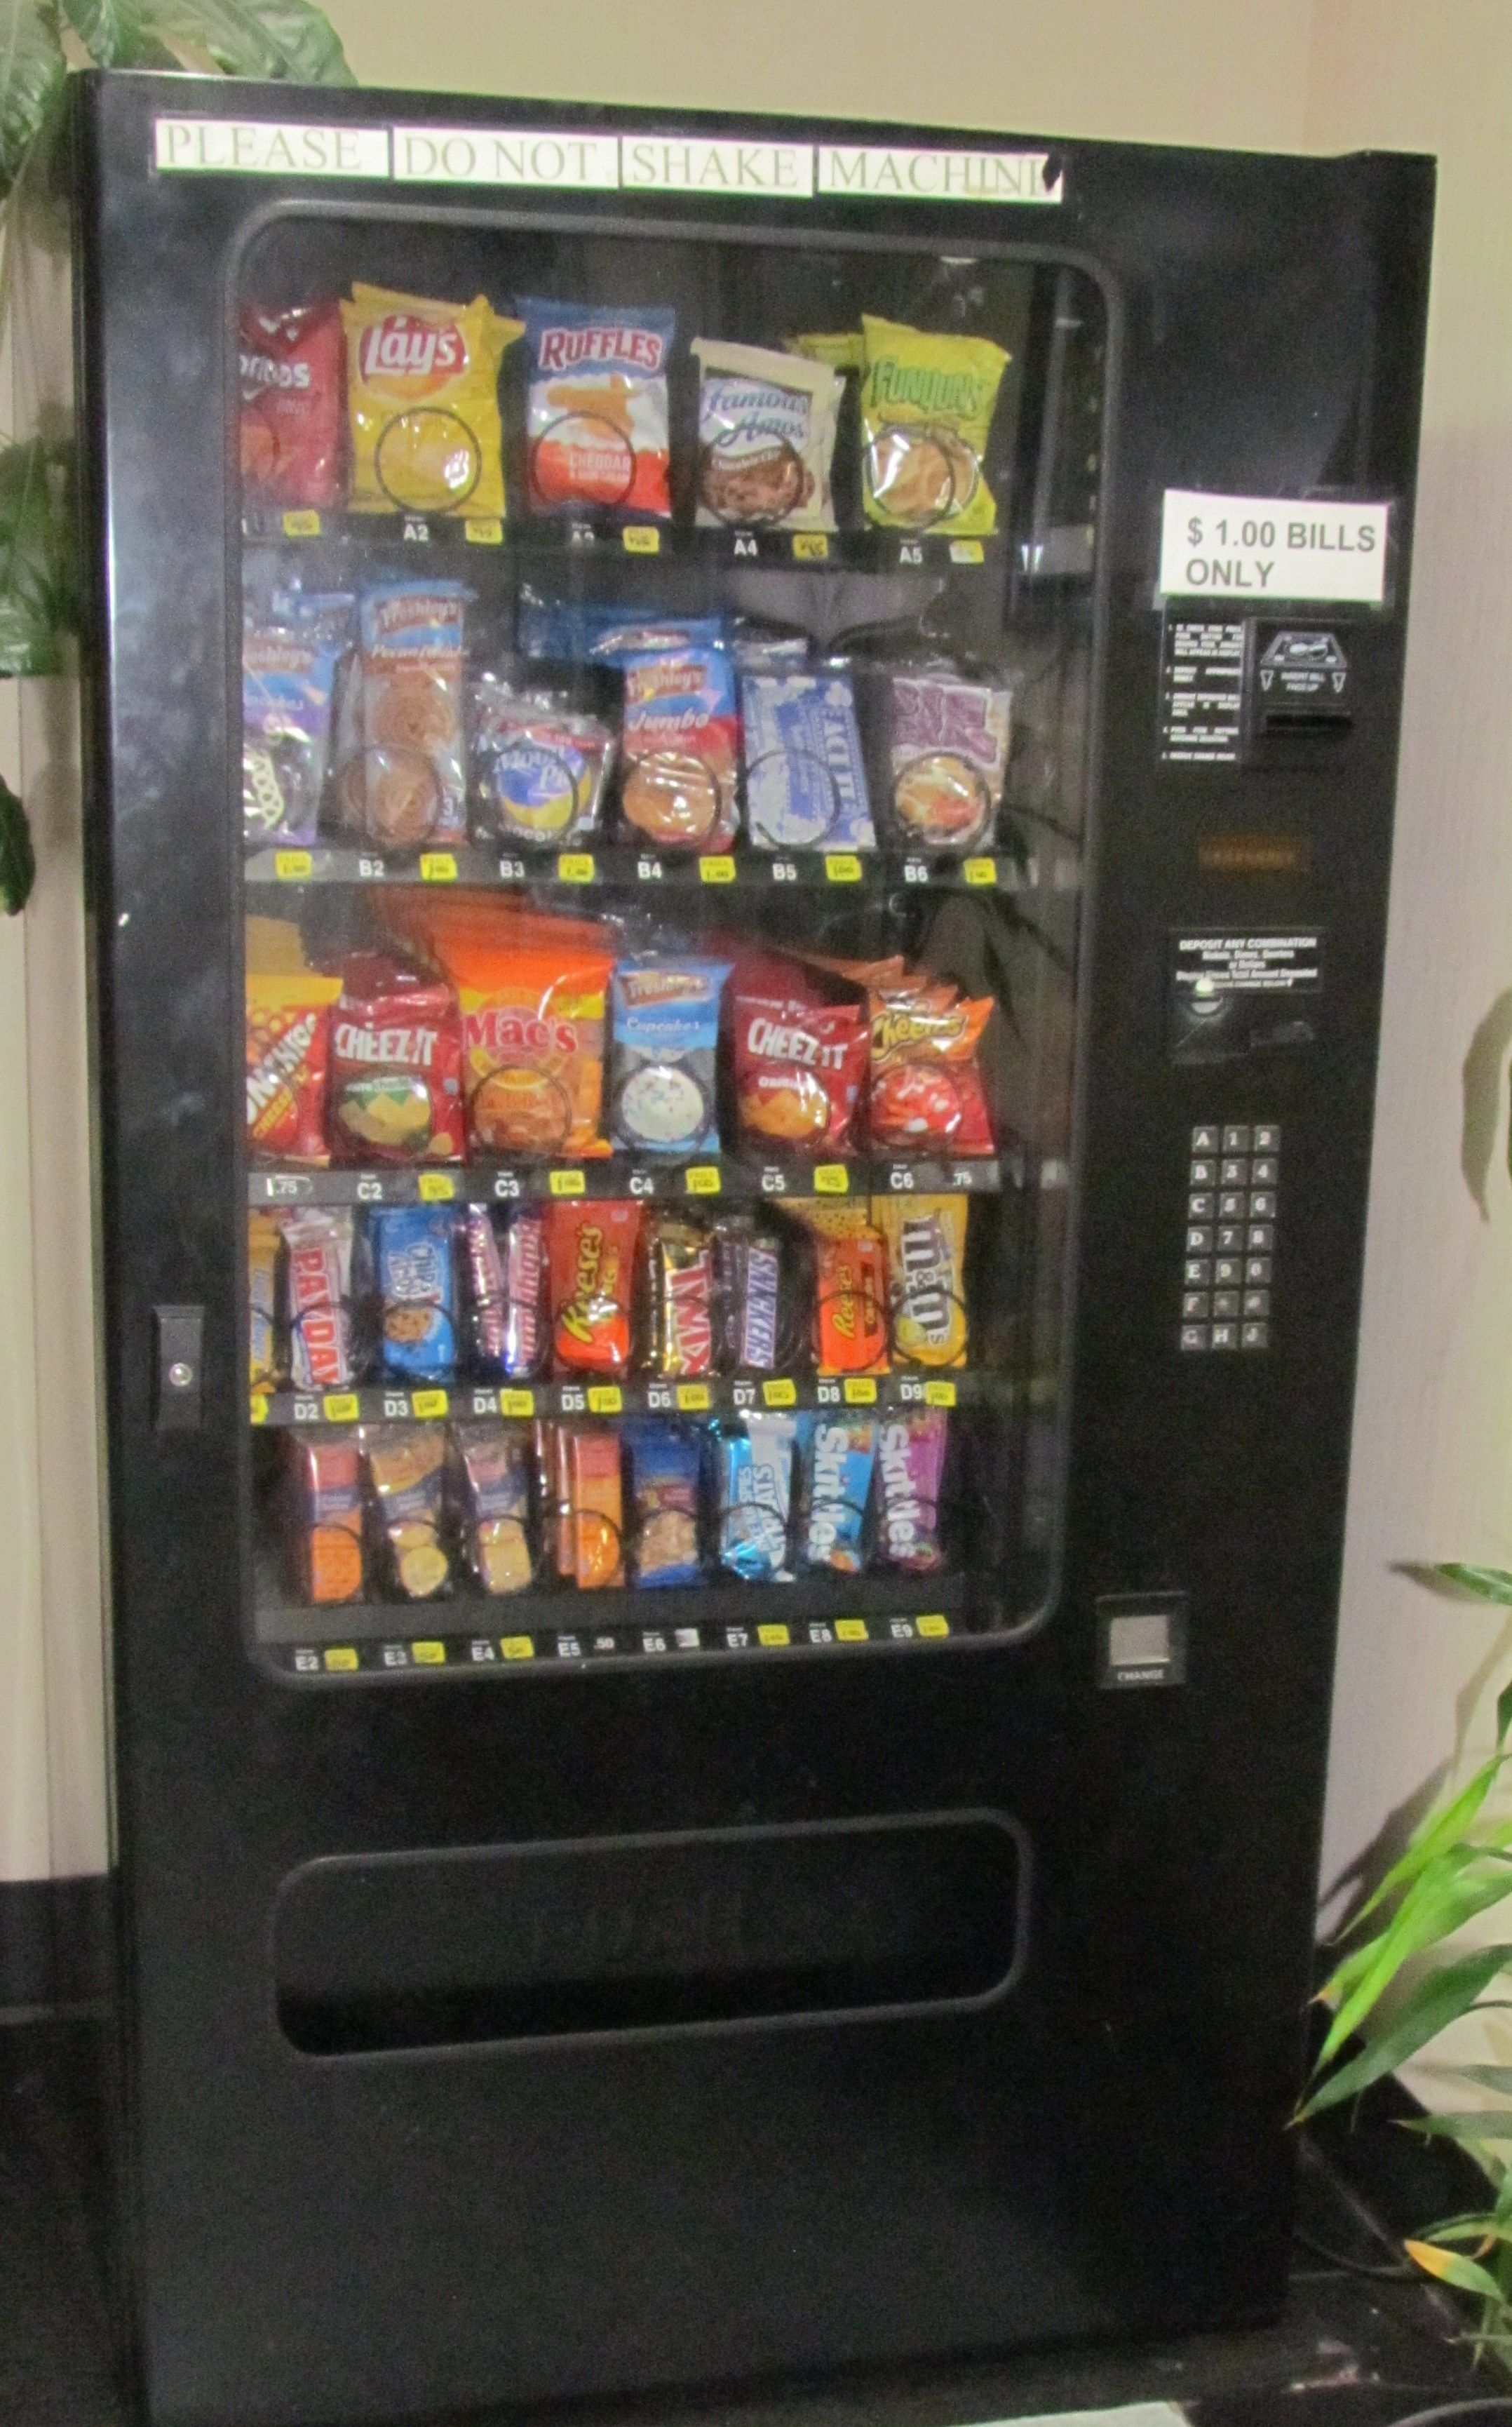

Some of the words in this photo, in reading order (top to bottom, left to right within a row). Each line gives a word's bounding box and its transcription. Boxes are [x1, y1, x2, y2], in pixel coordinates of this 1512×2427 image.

[165, 123, 363, 170] PLEASE
[403, 135, 477, 177] DO
[494, 138, 598, 180] NOT
[630, 142, 799, 189] SHAKE
[539, 326, 663, 371] RUFFLES
[403, 523, 429, 542] A2
[1187, 516, 1204, 547] $
[1215, 519, 1276, 548] 1.00
[1286, 521, 1376, 553] BILLS
[734, 538, 758, 556] A4
[900, 546, 923, 563] A5
[1185, 558, 1275, 588] ONLY
[627, 706, 710, 732] Jumbo
[359, 859, 386, 878] B2
[500, 859, 525, 878] B3
[637, 861, 663, 879] B4
[772, 863, 797, 881] B5
[904, 864, 930, 883] B6
[1179, 939, 1224, 951] DEPOSIT
[462, 1012, 579, 1053] Mac's
[1196, 1131, 1210, 1146] A
[1229, 1132, 1238, 1145] 1
[494, 1179, 520, 1197] C3
[630, 1176, 654, 1195] C4
[761, 1174, 785, 1192] C5
[891, 1171, 914, 1189] C6
[953, 1172, 973, 1186] .75
[357, 1181, 383, 1200] C2
[1192, 1197, 1206, 1213] C
[1190, 1231, 1204, 1246] D
[1222, 1231, 1233, 1245] 7
[647, 1392, 673, 1408] D6
[733, 1388, 756, 1405] D7
[817, 1386, 840, 1403] D8
[900, 1383, 924, 1401] D9
[384, 1401, 409, 1417] D3
[473, 1397, 497, 1414] D4
[561, 1394, 585, 1411] D5
[294, 1404, 319, 1420] D2
[809, 1629, 832, 1643] E8
[890, 1622, 914, 1638] E9
[642, 1637, 666, 1653] E6
[727, 1632, 749, 1648] E7
[471, 1645, 495, 1662] E4
[558, 1641, 581, 1658] E5
[295, 1654, 319, 1672] E2
